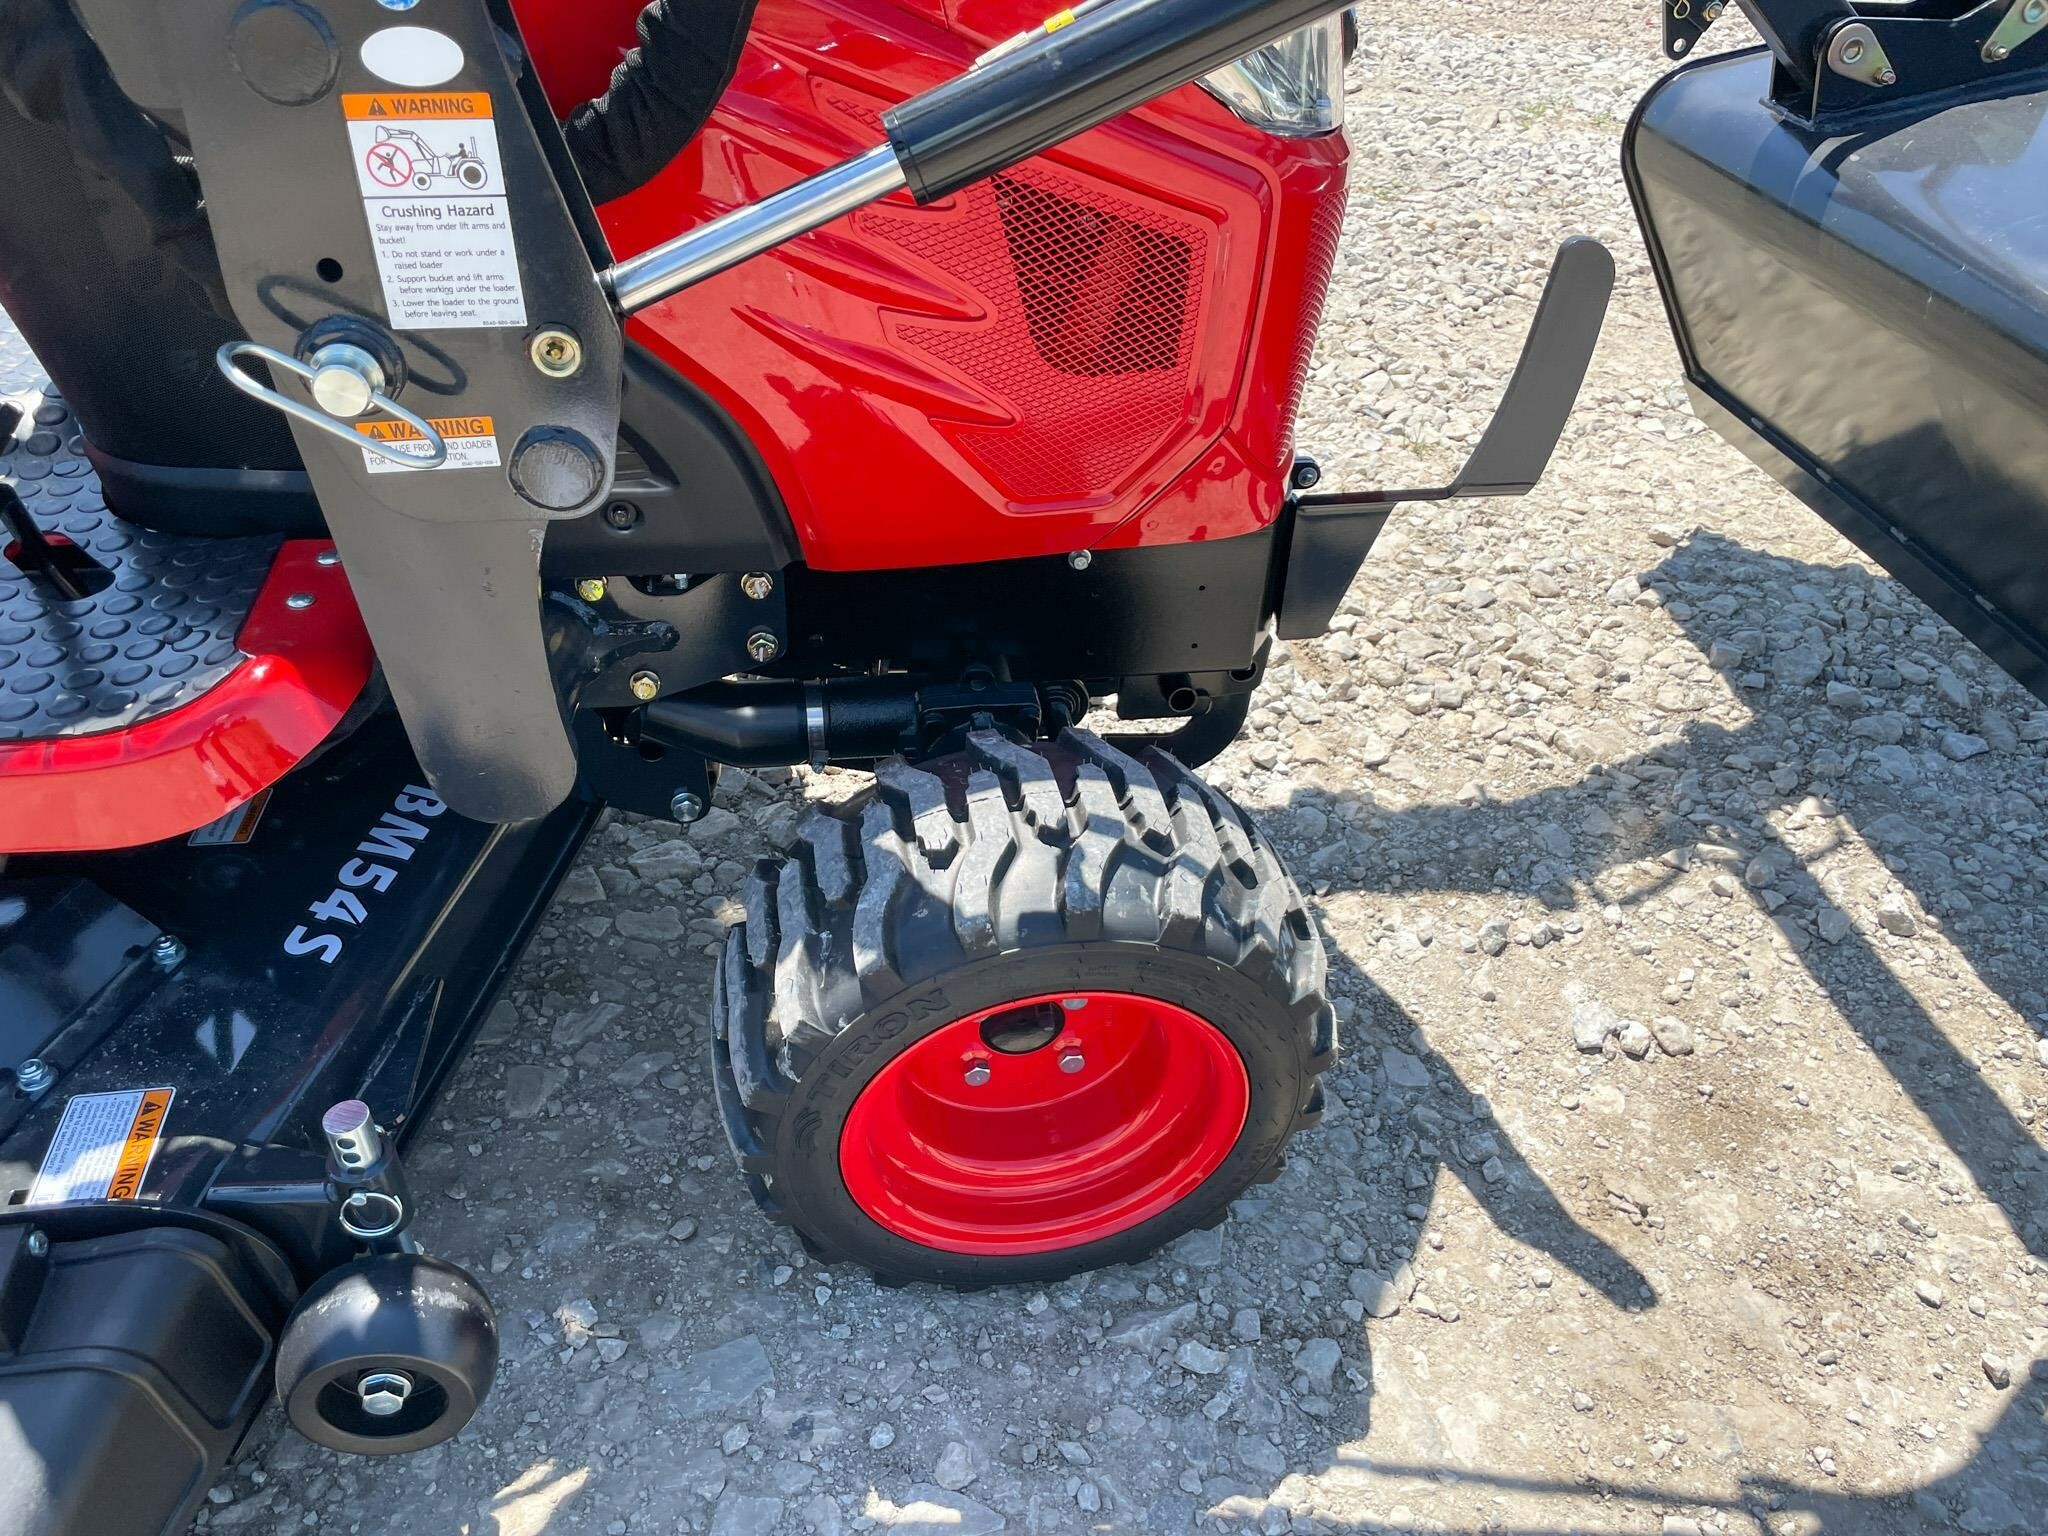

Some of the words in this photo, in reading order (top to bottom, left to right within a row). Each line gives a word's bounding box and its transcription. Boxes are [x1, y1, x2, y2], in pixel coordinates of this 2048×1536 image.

[392, 98, 473, 113] WARNING
[382, 205, 441, 220] Crushing
[447, 203, 494, 217] Hazard
[376, 224, 393, 233] Stay
[395, 225, 413, 233] away
[416, 223, 433, 231] from
[436, 222, 457, 230] under
[460, 222, 469, 230] lift
[379, 236, 406, 244] bucket!
[392, 250, 402, 258] Do
[395, 261, 417, 269] raised
[420, 261, 443, 269] loader
[397, 275, 426, 284] Support
[429, 274, 454, 282] bucket
[473, 273, 483, 281] lift
[400, 286, 423, 294] before
[425, 285, 454, 295] working
[479, 284, 491, 292] the
[493, 284, 517, 292] loader.
[493, 297, 519, 306] ground
[405, 310, 429, 318] before
[431, 310, 458, 318] leaving
[460, 309, 478, 317] seat.
[388, 419, 484, 438] WANING
[462, 440, 492, 449] LOADER
[370, 457, 386, 465] FOR
[284, 784, 448, 964] BM54S
[806, 988, 950, 1101] TIRON
[112, 1118, 157, 1199] WARNING
